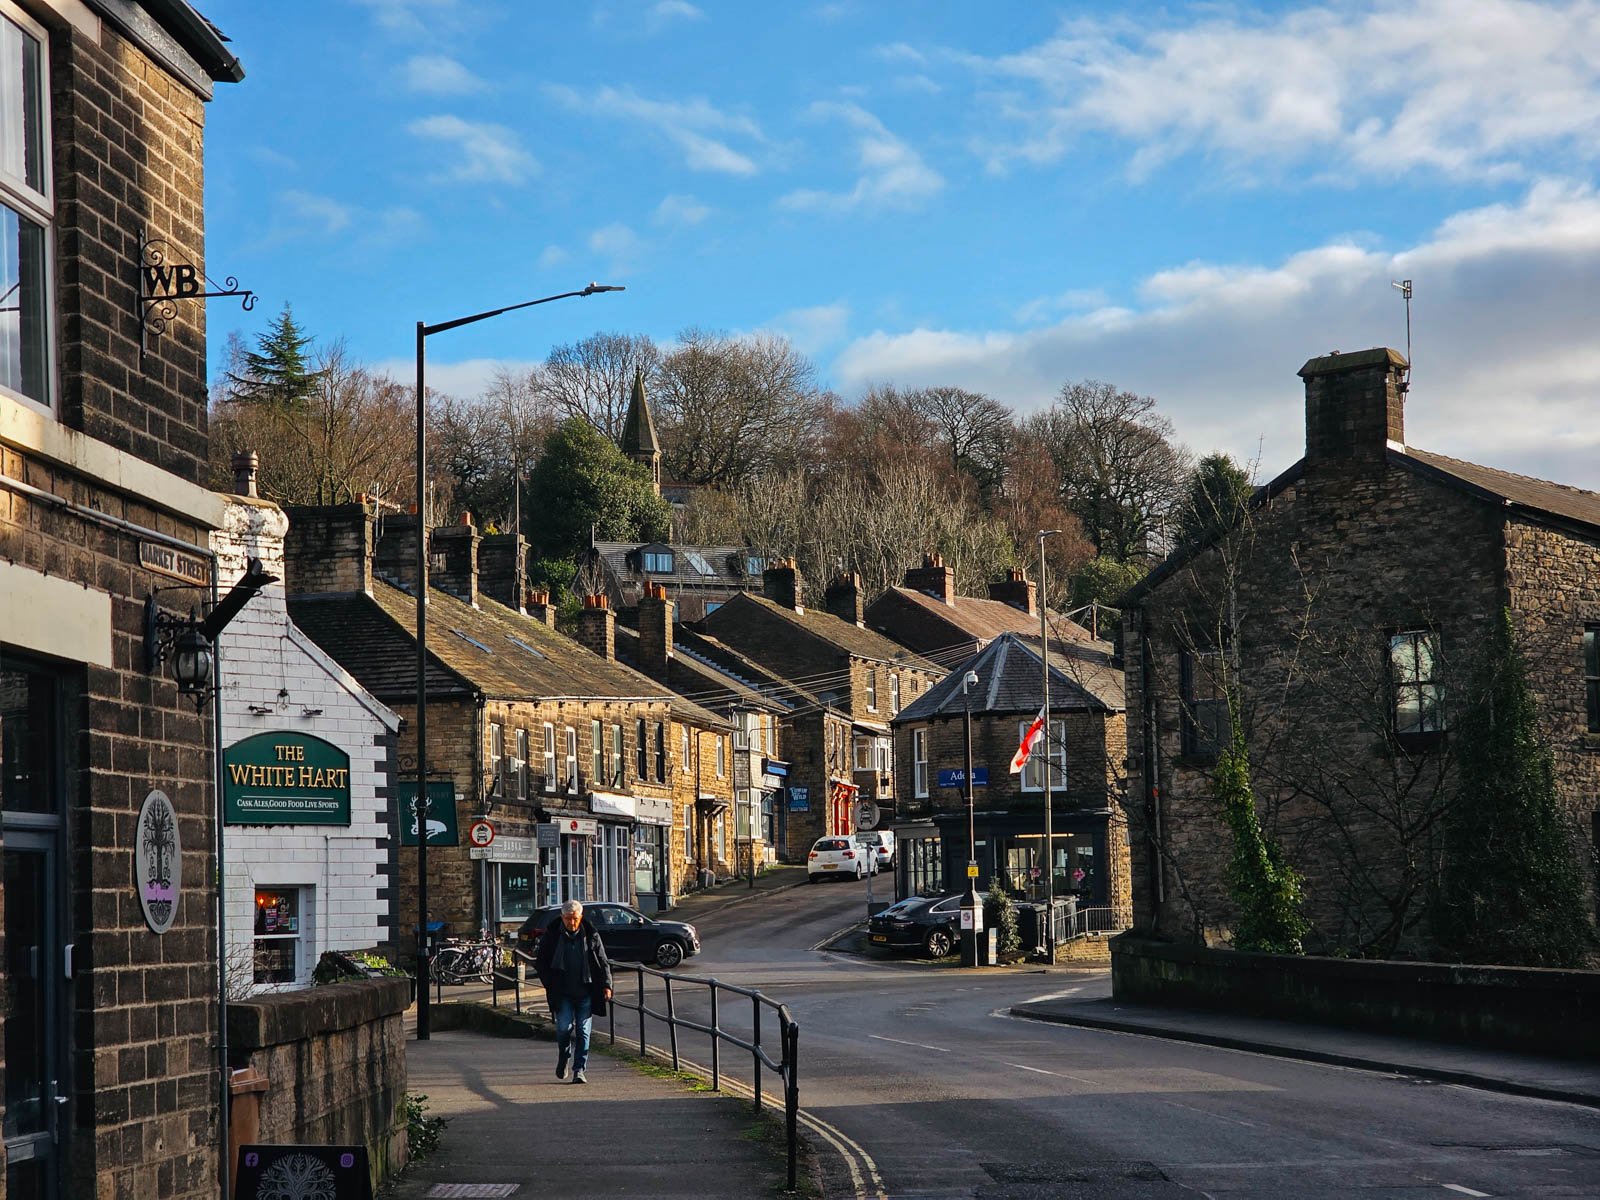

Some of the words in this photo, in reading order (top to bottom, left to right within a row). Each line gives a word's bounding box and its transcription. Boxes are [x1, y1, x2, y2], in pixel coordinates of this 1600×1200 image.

[141, 265, 199, 297] WB
[142, 543, 174, 571] MARKET
[177, 553, 205, 582] STREET
[275, 746, 304, 761] THE
[229, 764, 295, 787] WHITE
[299, 766, 348, 788] HART
[236, 799, 253, 807] CASK
[287, 800, 304, 808] FOOD
[318, 801, 339, 809] SPORTS
